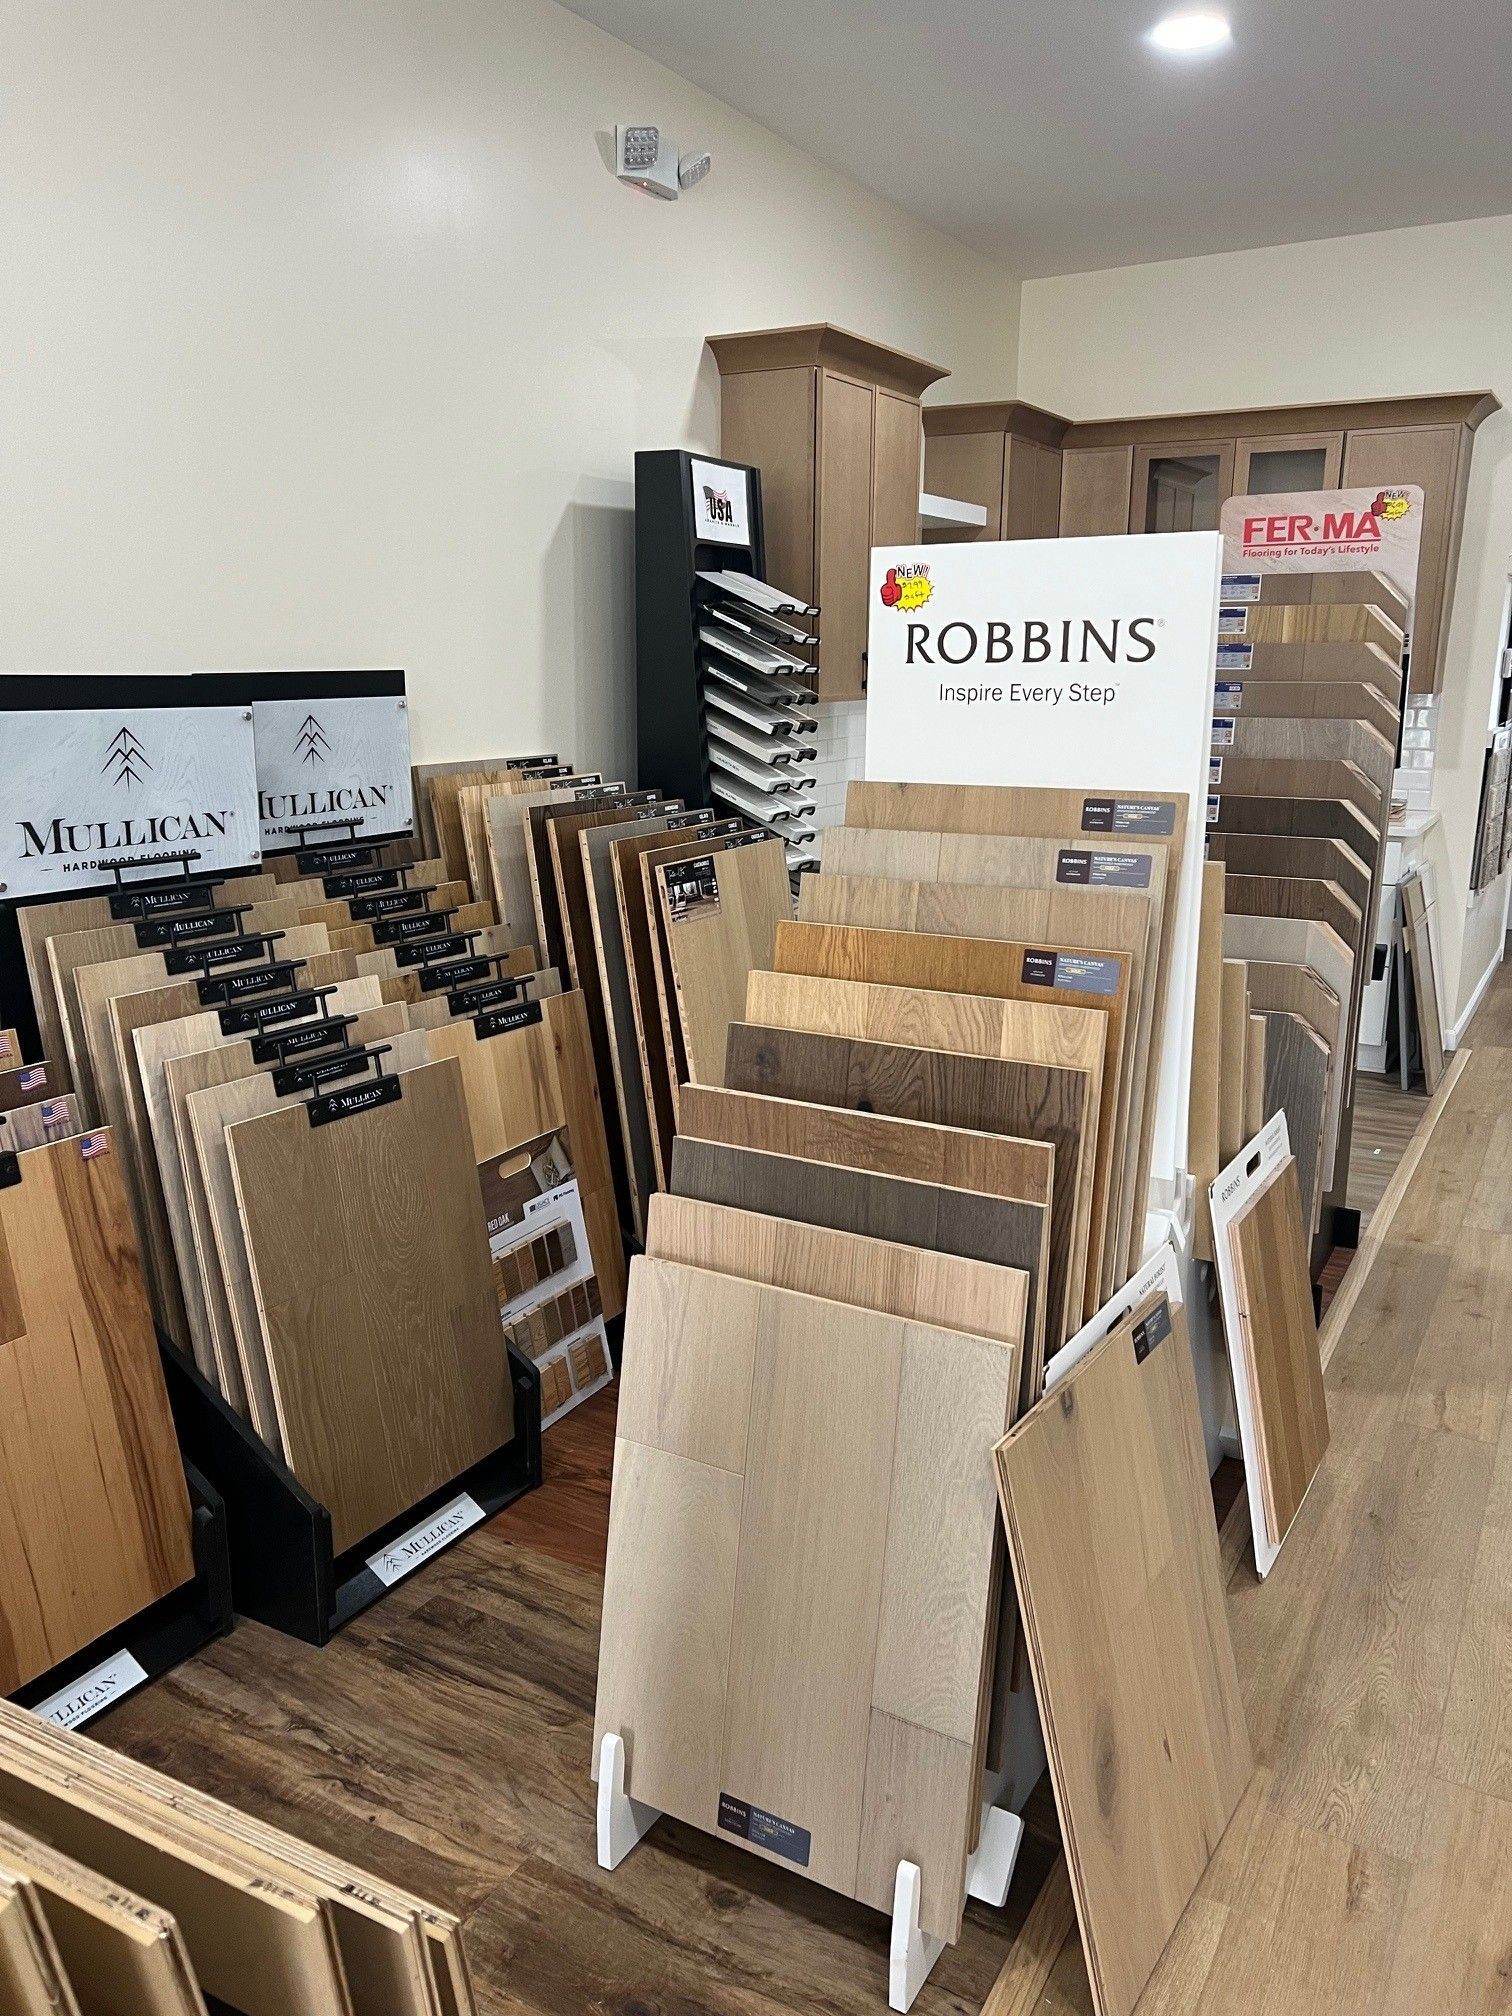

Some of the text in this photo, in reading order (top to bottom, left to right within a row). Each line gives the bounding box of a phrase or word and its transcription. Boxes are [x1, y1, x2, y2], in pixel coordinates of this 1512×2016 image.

[709, 498, 733, 522] USA
[1242, 543, 1379, 558] Flooring for Today's Lifestyle
[905, 617, 1157, 665] ROBBINS
[939, 683, 1116, 706] Inspire Every Step
[15, 811, 228, 858] MULLICAN
[340, 1089, 382, 1108] MULLICAN
[401, 1511, 464, 1559] MULLICAN
